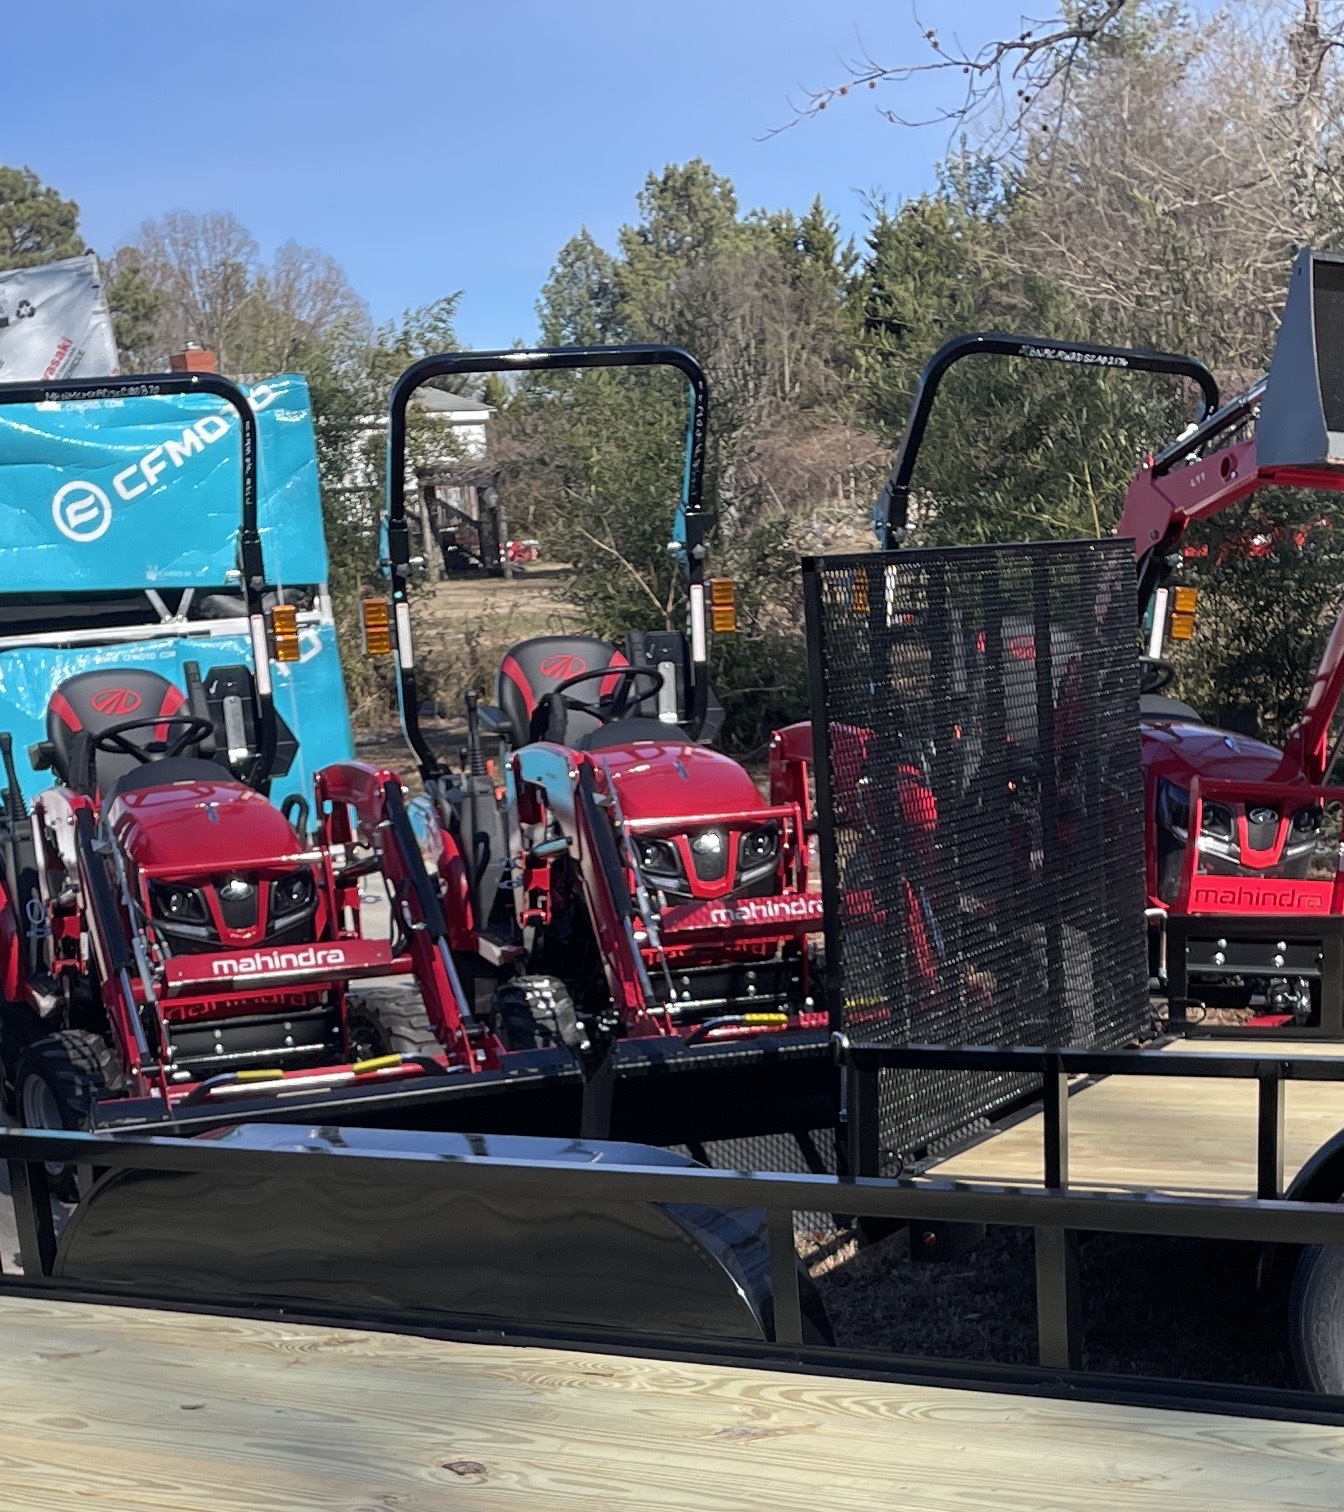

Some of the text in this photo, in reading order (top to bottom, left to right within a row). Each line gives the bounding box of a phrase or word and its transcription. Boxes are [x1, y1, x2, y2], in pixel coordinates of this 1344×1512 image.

[41, 336, 74, 380] asaki
[112, 385, 275, 500] CFMOO
[1195, 886, 1323, 909] mahindra
[212, 947, 345, 975] mahindra
